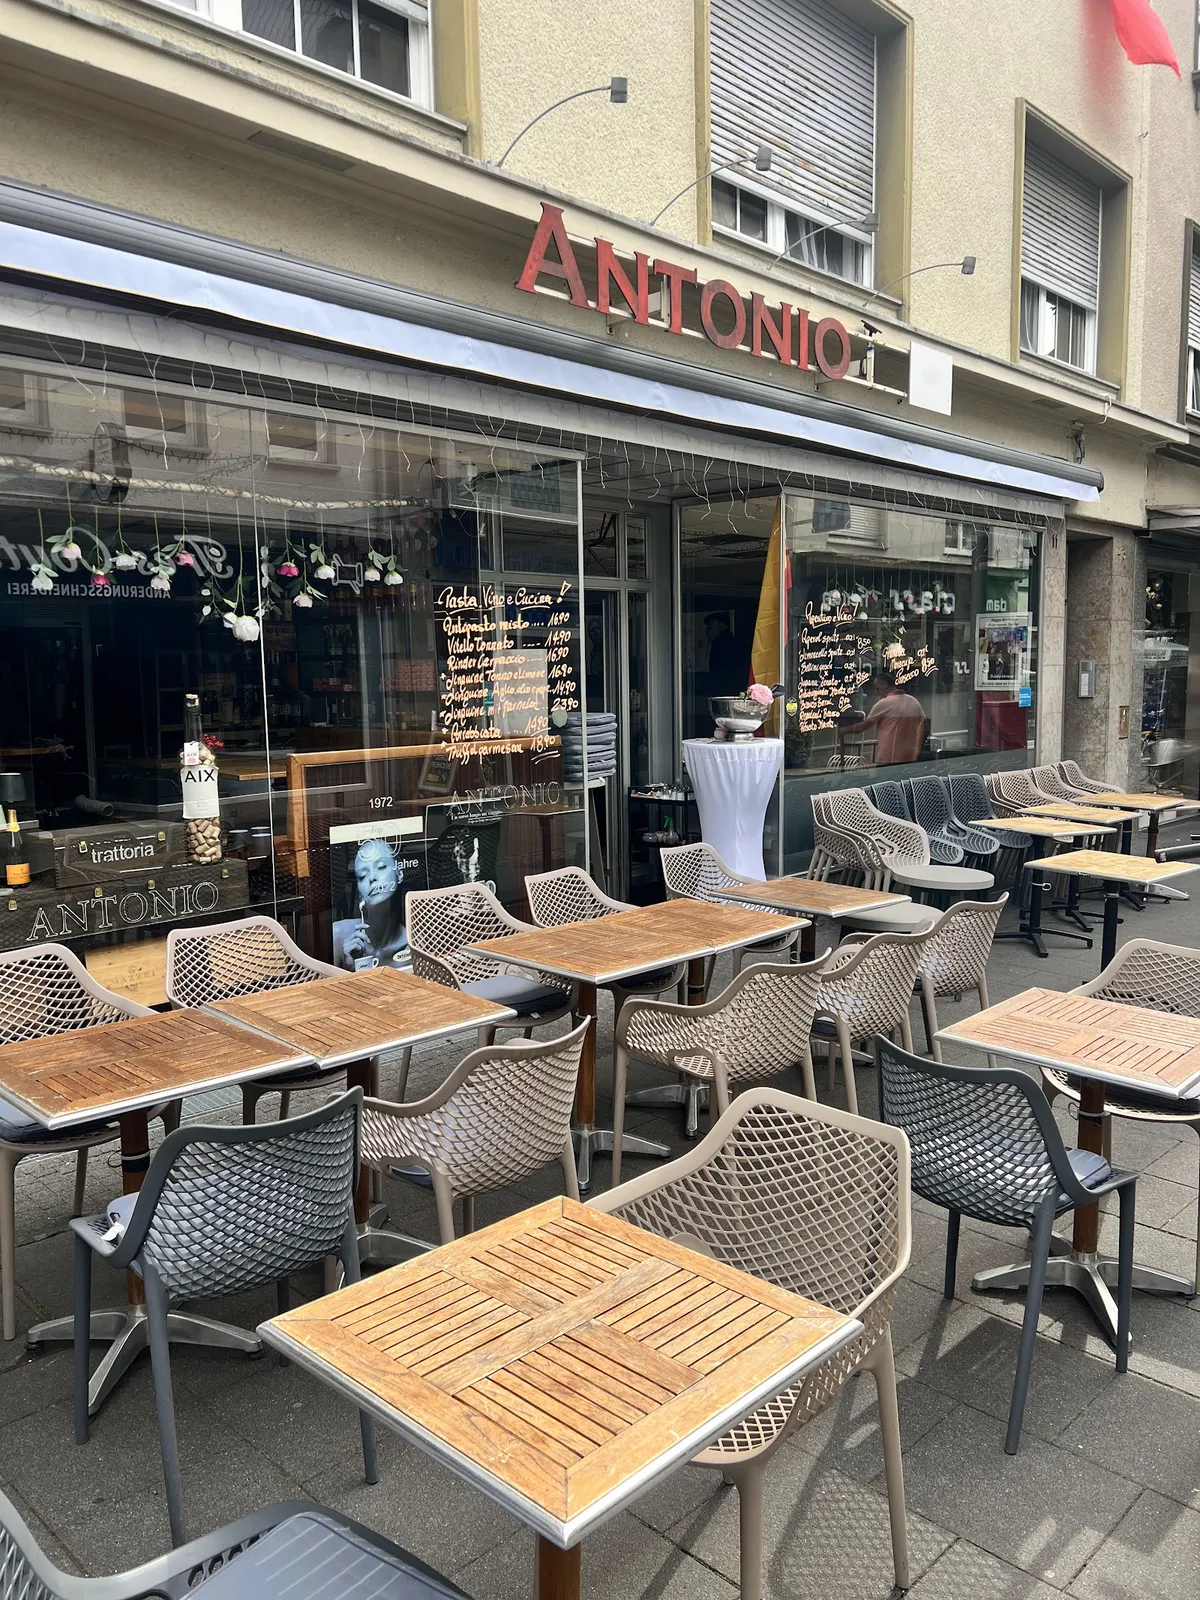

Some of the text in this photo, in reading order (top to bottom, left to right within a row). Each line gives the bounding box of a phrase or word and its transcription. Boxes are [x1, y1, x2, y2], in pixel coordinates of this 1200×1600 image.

[514, 201, 851, 380] ANTONIO
[483, 585, 505, 607] Vino
[507, 596, 514, 605] e
[185, 769, 215, 783] AIX
[368, 796, 393, 809] 1972
[446, 781, 561, 816] ANTONIO
[91, 842, 155, 864] trattoria
[392, 858, 419, 871] Jahre
[372, 881, 396, 895] 2022
[26, 881, 220, 942] ANTONIO
